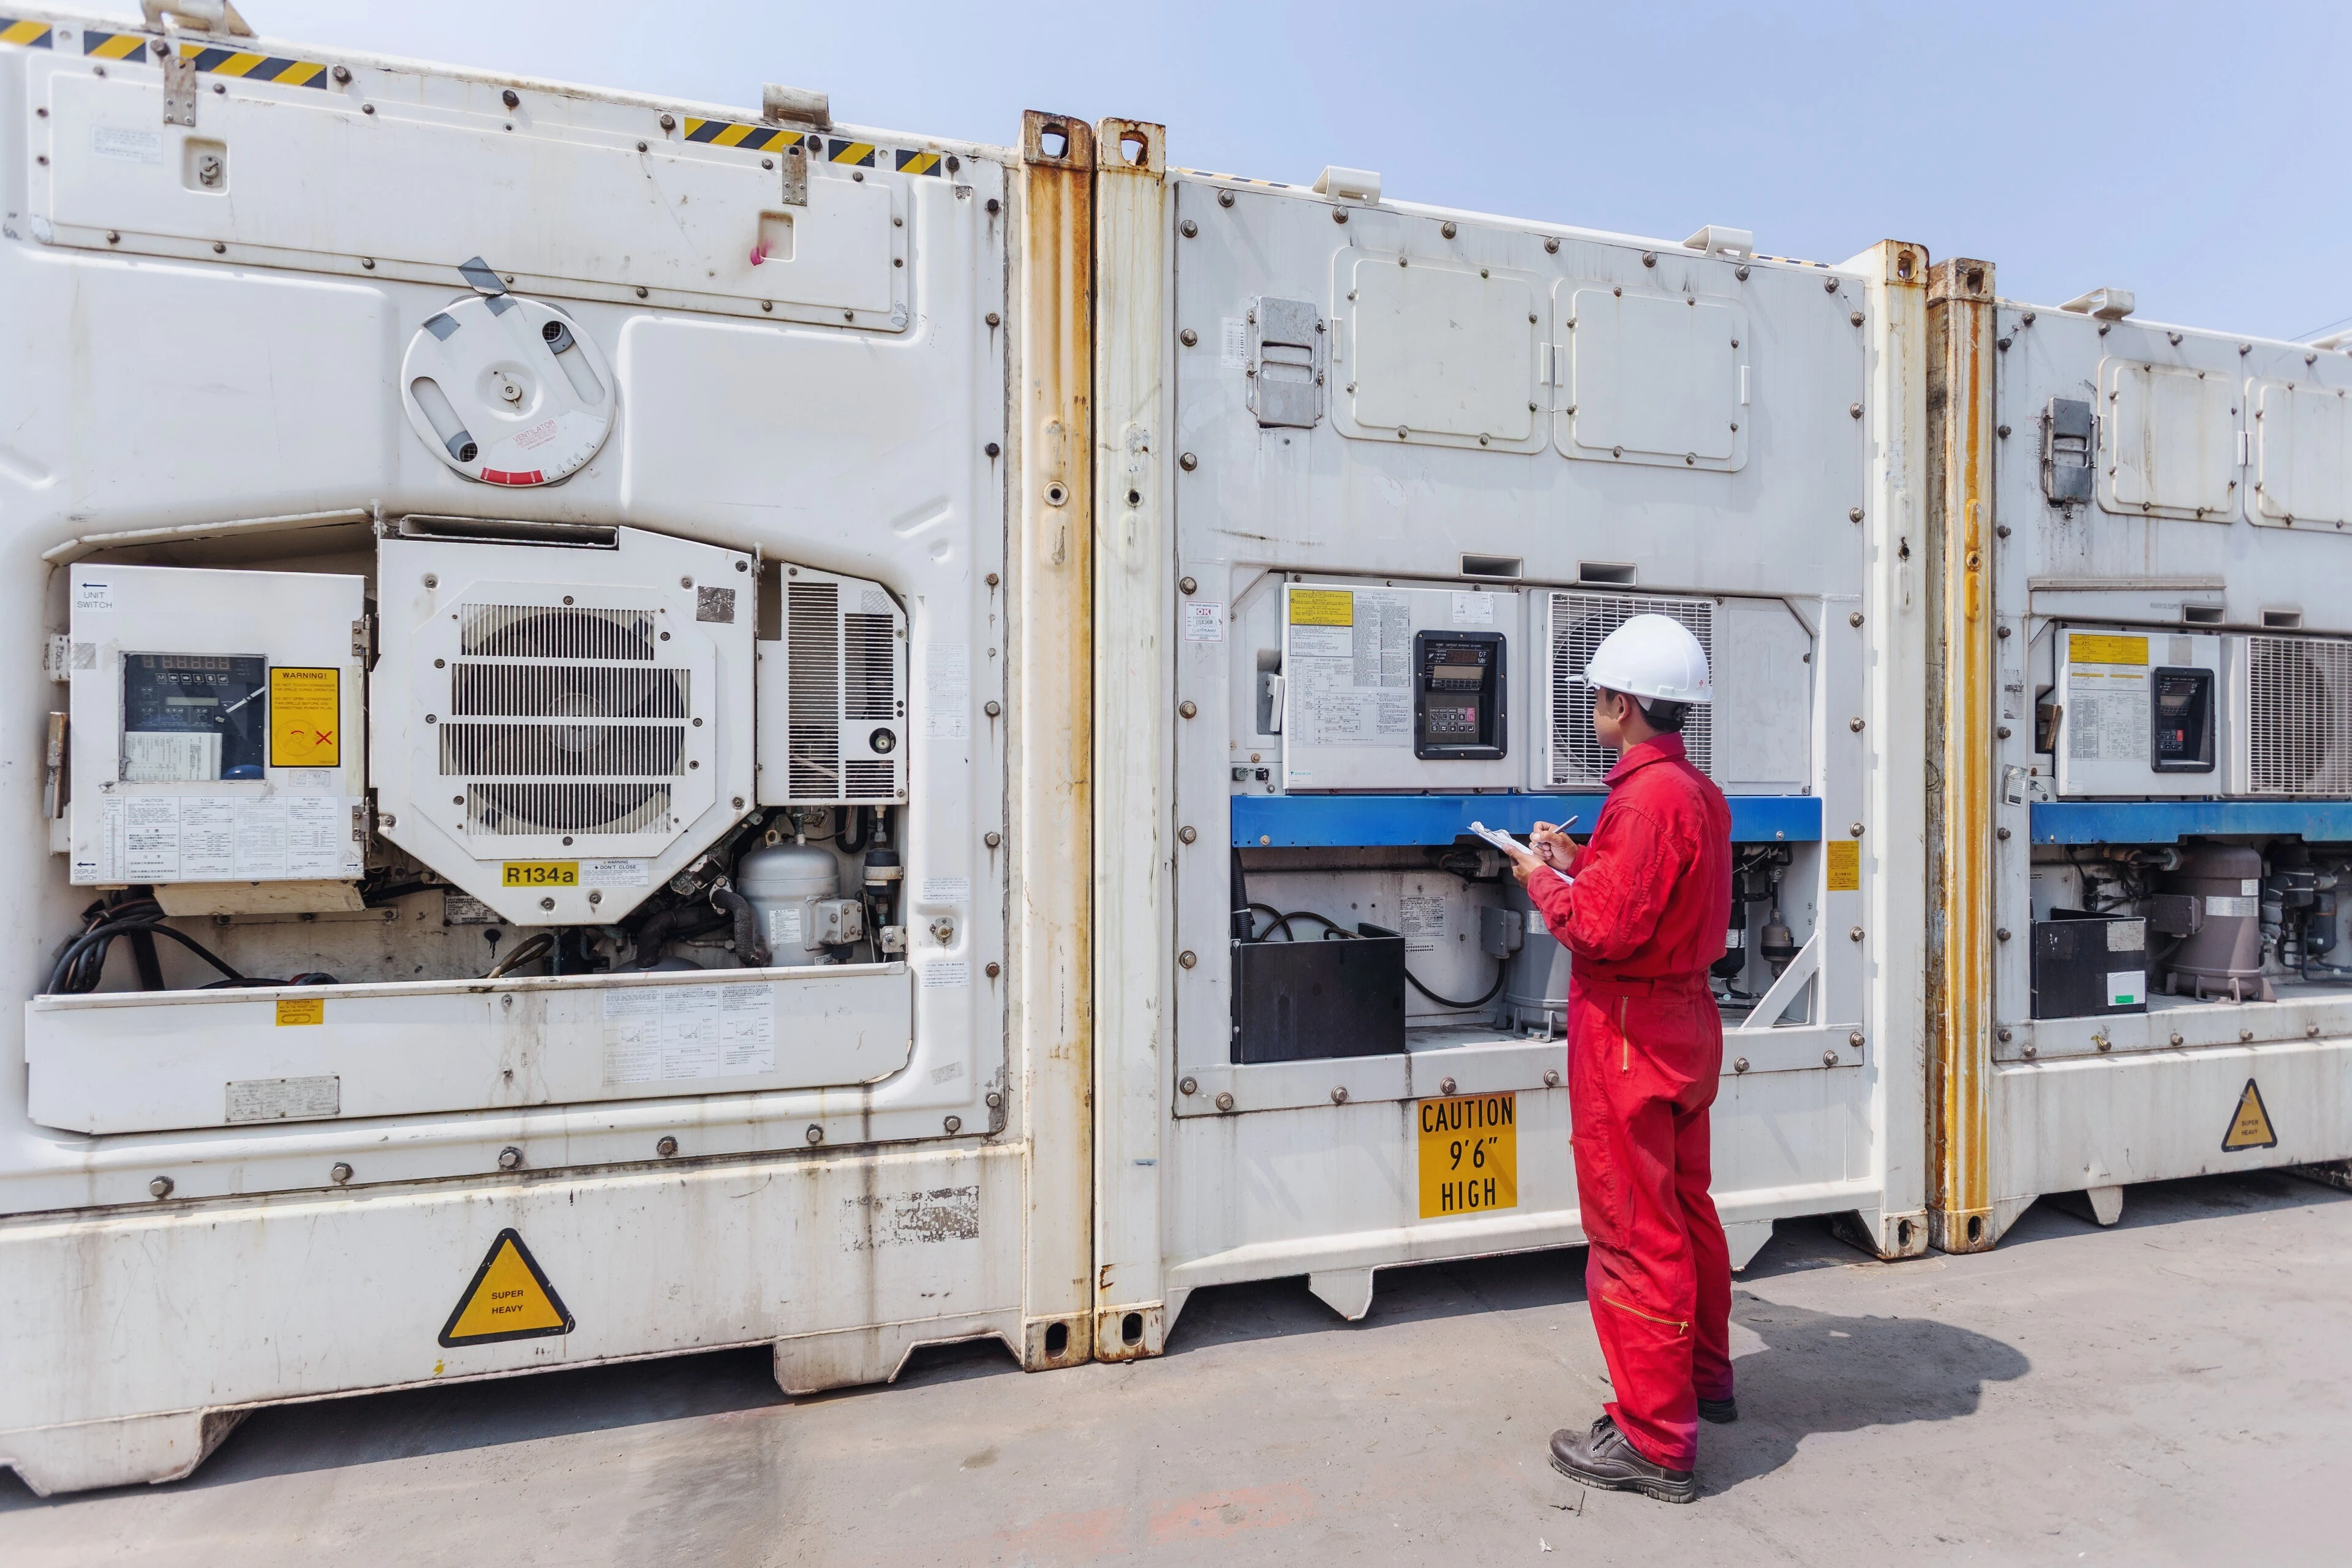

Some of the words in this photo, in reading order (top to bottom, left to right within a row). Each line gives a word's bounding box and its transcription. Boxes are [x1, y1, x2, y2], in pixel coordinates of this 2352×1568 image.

[512, 420, 556, 442] VENTILATOR
[507, 867, 574, 883] R134a
[1422, 1097, 1513, 1133] CAUTION
[1441, 1177, 1496, 1212] HIGH
[492, 1290, 524, 1300] SUPER
[492, 1305, 524, 1314] HEAVY
